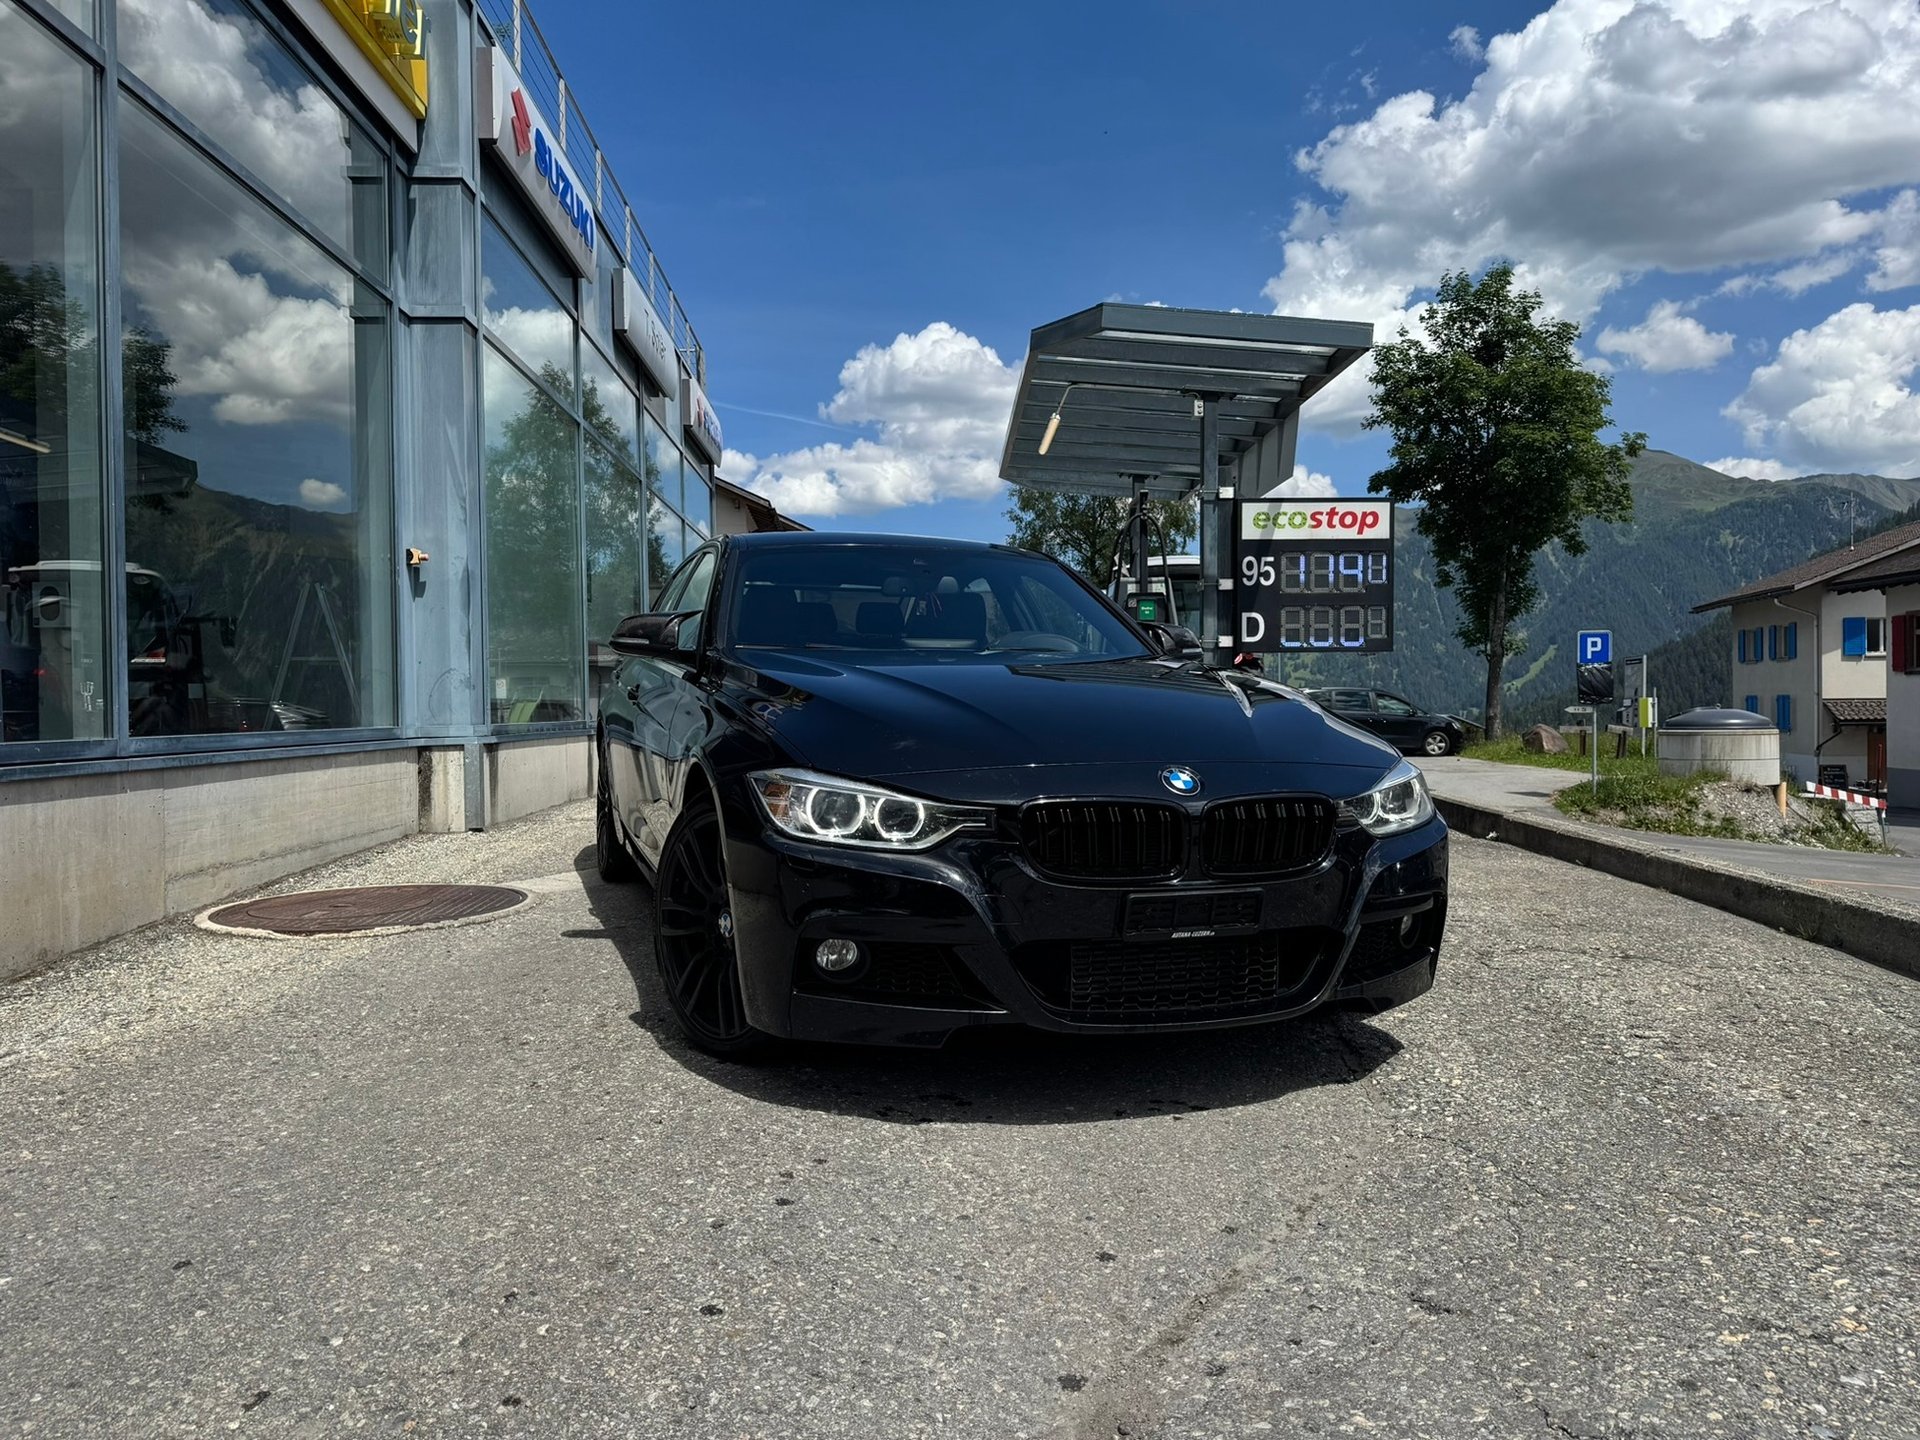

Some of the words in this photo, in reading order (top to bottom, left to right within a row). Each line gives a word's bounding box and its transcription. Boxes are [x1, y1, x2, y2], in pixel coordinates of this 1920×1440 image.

[534, 127, 593, 252] SUZUKI
[1252, 507, 1379, 535] ecostop
[1242, 555, 1276, 586] 95
[1241, 612, 1265, 643] D
[1587, 637, 1602, 659] P
